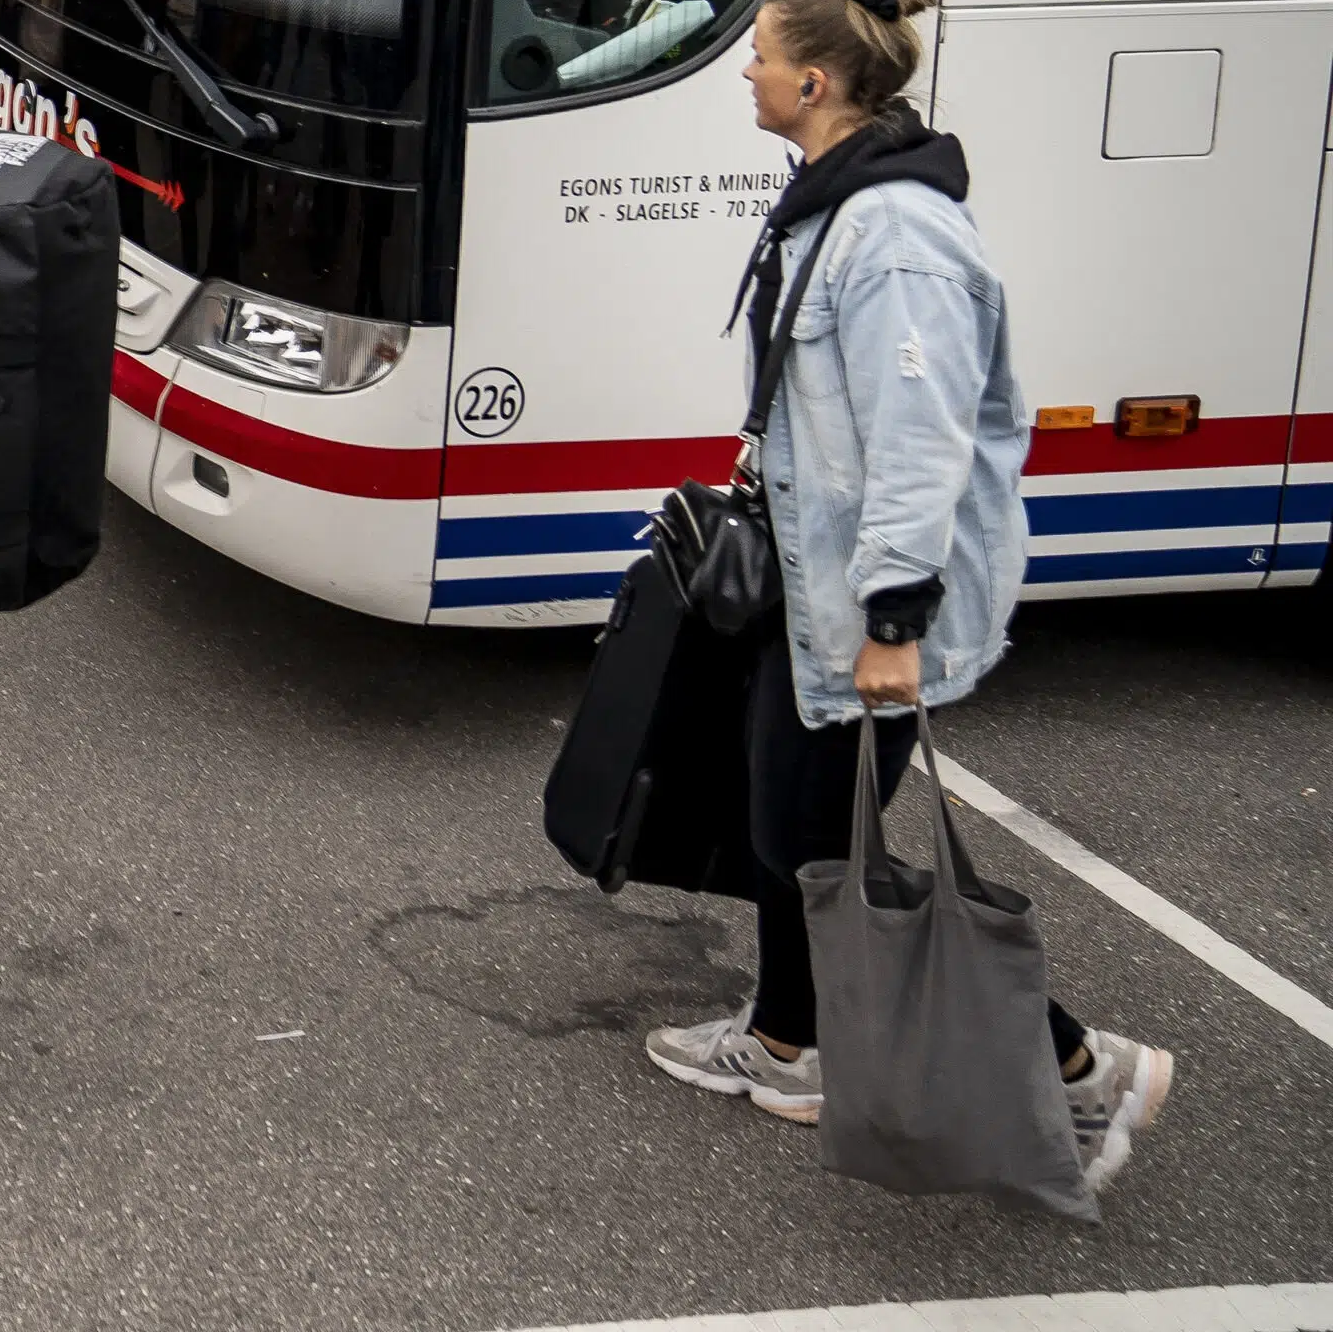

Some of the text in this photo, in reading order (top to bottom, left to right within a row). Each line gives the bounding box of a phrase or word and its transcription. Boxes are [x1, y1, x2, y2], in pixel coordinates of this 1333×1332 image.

[560, 178, 622, 197] EGONS
[629, 176, 692, 195] TURIST
[699, 175, 711, 192] &
[565, 205, 590, 223] DK
[616, 201, 700, 221] SLAGELSE
[726, 199, 746, 218] 70
[751, 199, 771, 217] 20
[464, 384, 516, 421] 226
